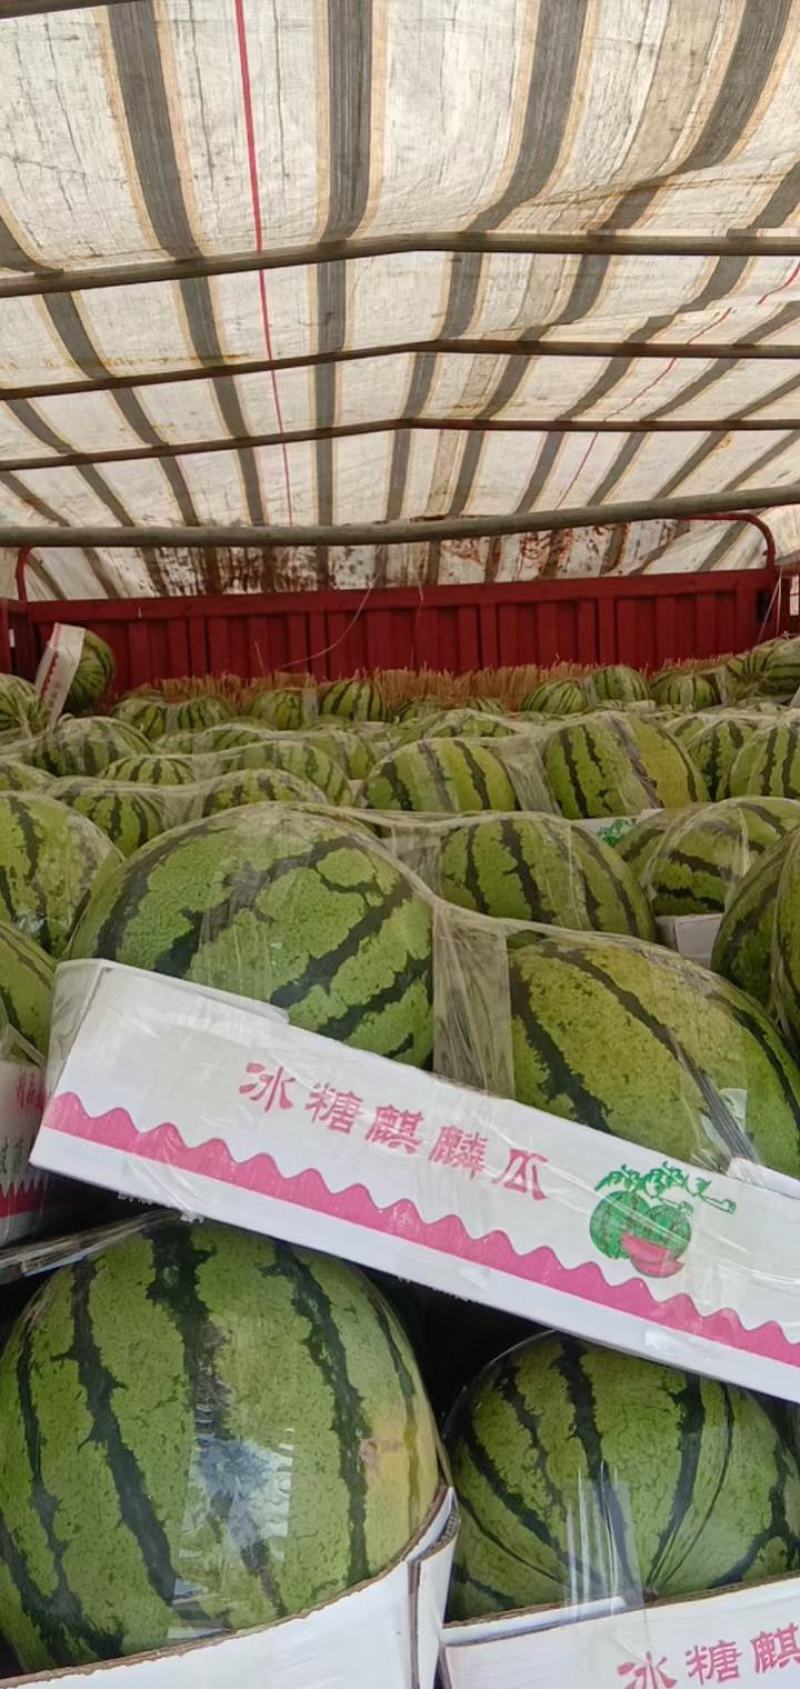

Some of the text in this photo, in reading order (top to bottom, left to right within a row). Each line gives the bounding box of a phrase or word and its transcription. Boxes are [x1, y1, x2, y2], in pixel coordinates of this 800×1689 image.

[239, 1061, 548, 1200] 冰糖麒麟瓜
